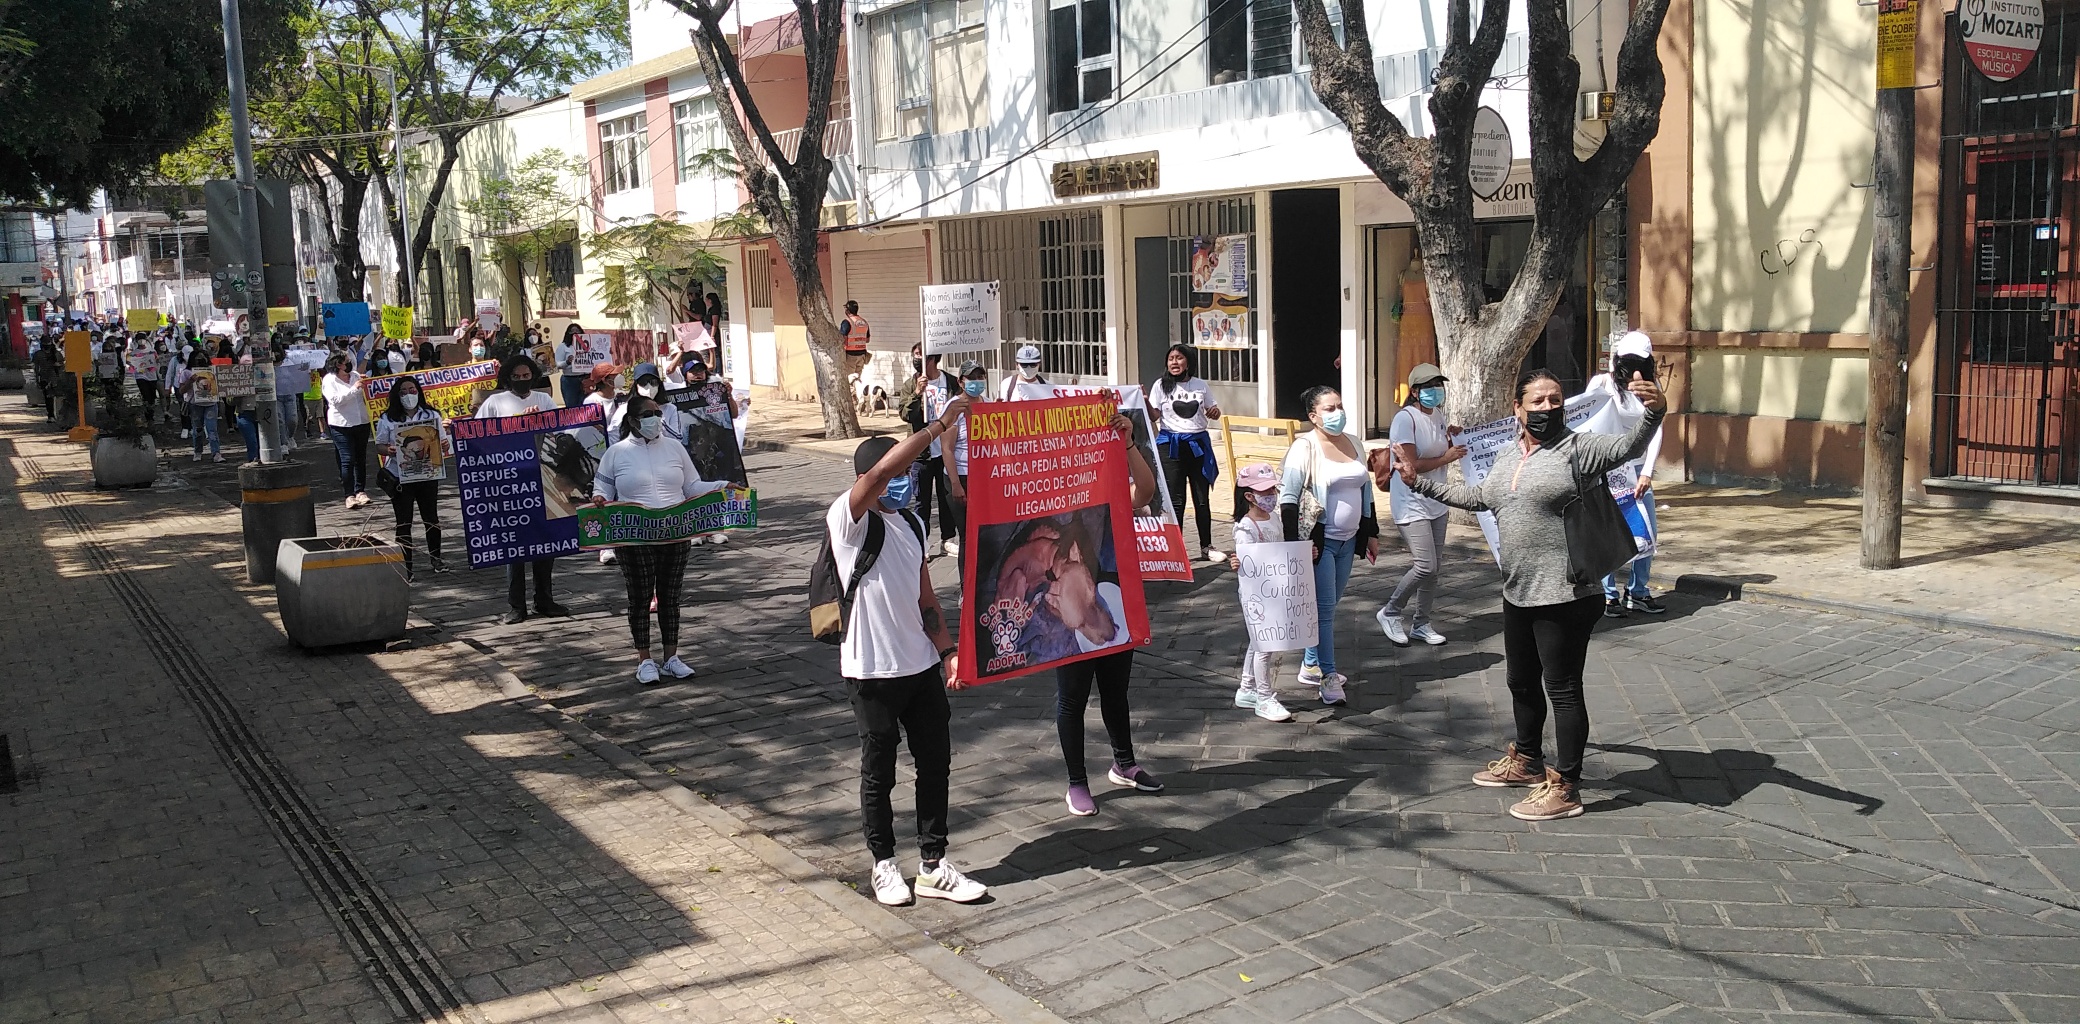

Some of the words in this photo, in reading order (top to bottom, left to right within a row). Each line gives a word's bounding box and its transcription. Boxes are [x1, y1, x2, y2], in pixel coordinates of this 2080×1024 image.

[1991, 1, 2040, 17] INSTITUTO
[1982, 12, 2044, 40] MOZART
[1977, 48, 2010, 61] ESCUELA
[2012, 53, 2022, 62] DE
[1493, 202, 1528, 215] BOUTIQUE
[938, 306, 951, 315] más
[382, 317, 409, 327] ANIMAL
[946, 318, 954, 327] de
[927, 329, 951, 338] Acciones
[953, 331, 957, 339] y
[957, 328, 971, 336] leyes
[986, 326, 995, 335] que
[453, 396, 466, 406] UN
[675, 392, 690, 403] SOLO
[454, 405, 468, 416] SE
[1584, 411, 1591, 420] y
[454, 421, 484, 440] ¡ALTO
[486, 419, 500, 437] AL
[501, 415, 557, 434] MALTRATO
[559, 405, 603, 427] ANIMAL!
[970, 410, 1015, 441] BASTA
[1017, 410, 1026, 436] A
[1028, 409, 1043, 434] LA
[456, 440, 468, 452] El
[971, 443, 999, 460] UNA
[1001, 439, 1037, 457] MUERTE
[1039, 435, 1066, 451] LENTA
[1068, 436, 1074, 449] Y
[1076, 430, 1120, 448] DOLOROSA
[1481, 438, 1506, 450] Libre
[459, 449, 535, 468] ABANDONO
[990, 461, 1029, 479] AFRICA
[1031, 457, 1058, 473] PEDIA
[1060, 454, 1072, 468] EN
[1074, 449, 1106, 467] SILENCIO
[461, 467, 519, 484] DESPUES
[1003, 483, 1019, 498] UN
[1022, 477, 1051, 495] POCO
[1053, 475, 1064, 490] DE
[1066, 471, 1097, 488] COMIDA
[463, 488, 481, 500] DE
[485, 481, 538, 498] LUCRAR
[466, 501, 499, 516] CON
[503, 496, 542, 512] ELLOS
[1016, 495, 1066, 517] LLEGAMOS
[1068, 490, 1090, 507] TARDE
[609, 511, 622, 527] SÉ
[625, 514, 640, 527] UN
[681, 500, 751, 525] RESPONSABLE
[468, 520, 483, 533] ES
[490, 514, 531, 529] ALGO
[612, 527, 671, 541] ESTERILIZA
[674, 522, 693, 537] TUS
[696, 513, 748, 531] MASCOTAS
[470, 533, 498, 548] QUE
[501, 531, 517, 543] SE
[472, 549, 504, 564] DEBE
[508, 546, 525, 559] DE
[529, 538, 579, 556] FRENAR
[980, 598, 1033, 627] Cambia
[1007, 610, 1026, 627] vida
[986, 652, 1027, 671] ADOPTA
